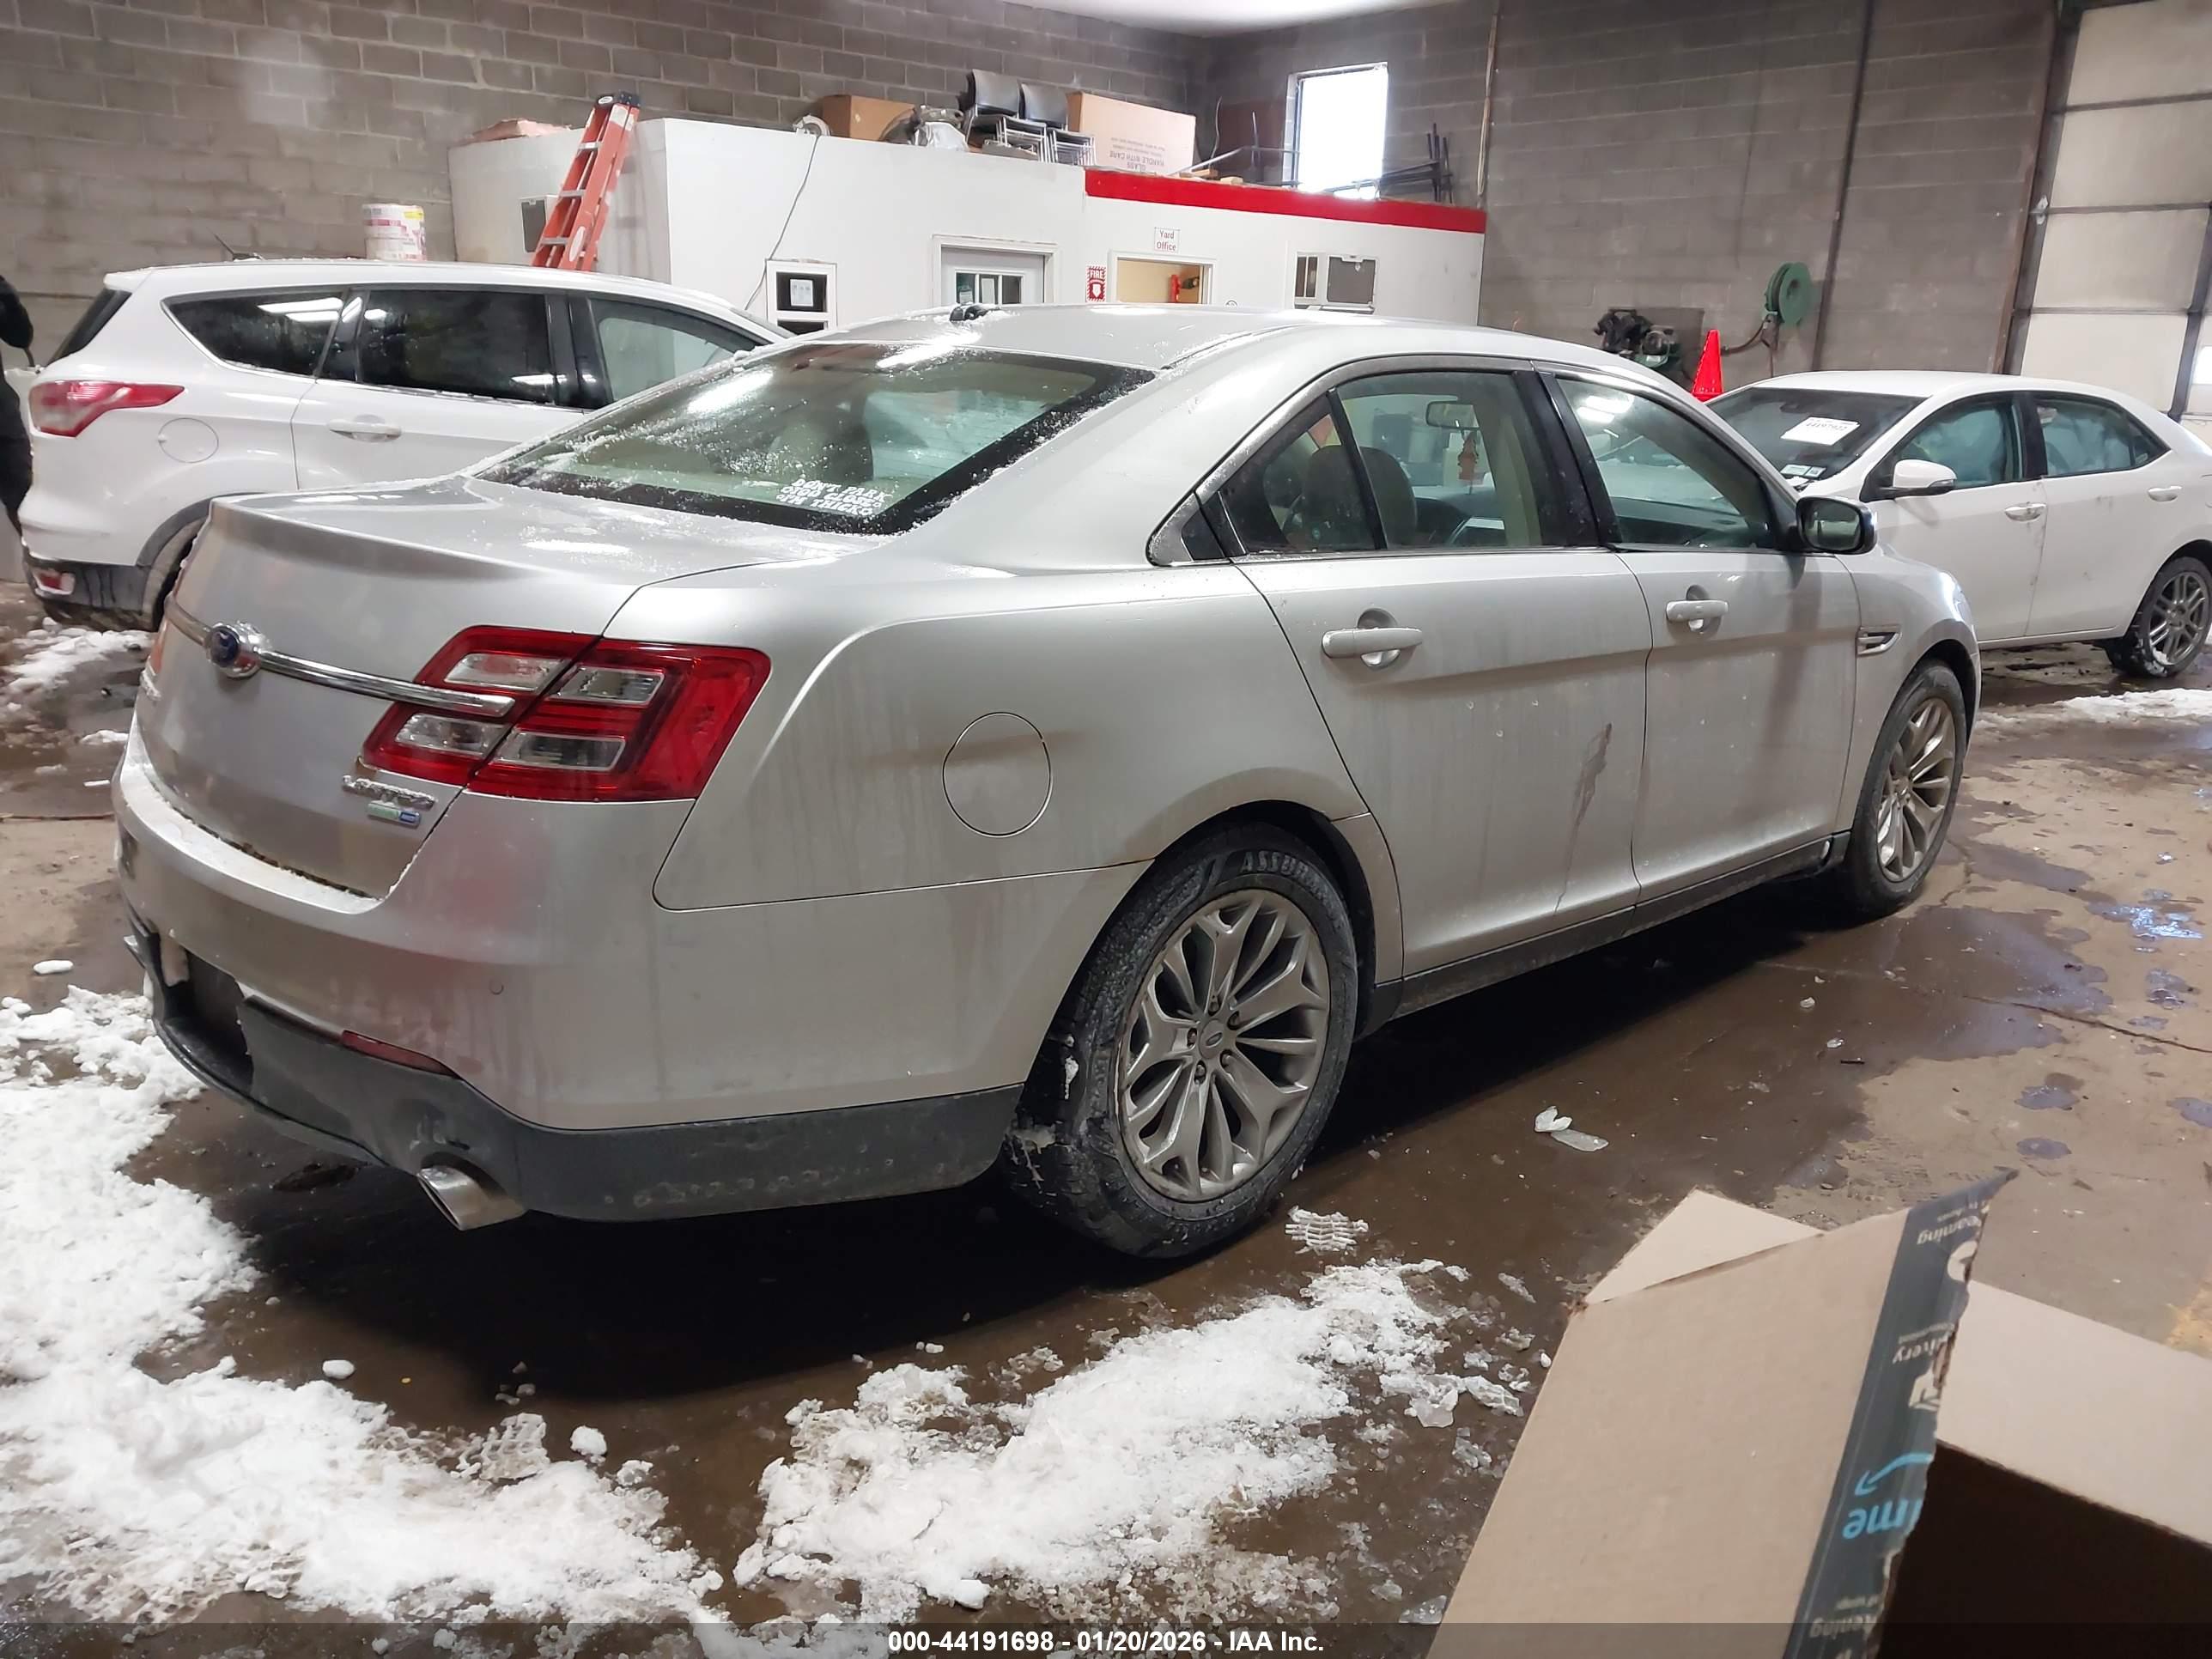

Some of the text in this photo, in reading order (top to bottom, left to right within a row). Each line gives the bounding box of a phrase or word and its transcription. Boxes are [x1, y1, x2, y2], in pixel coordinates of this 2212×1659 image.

[1109, 150, 1126, 159] CARE
[1127, 154, 1141, 163] WITH
[1141, 157, 1164, 167] HANDLE
[1159, 230, 1175, 240] Yard
[1156, 241, 1176, 252] Office
[1090, 270, 1103, 279] FIRE
[791, 478, 893, 502] DON'T PARK
[823, 492, 874, 507] CLOSE
[810, 499, 861, 515] THICK
